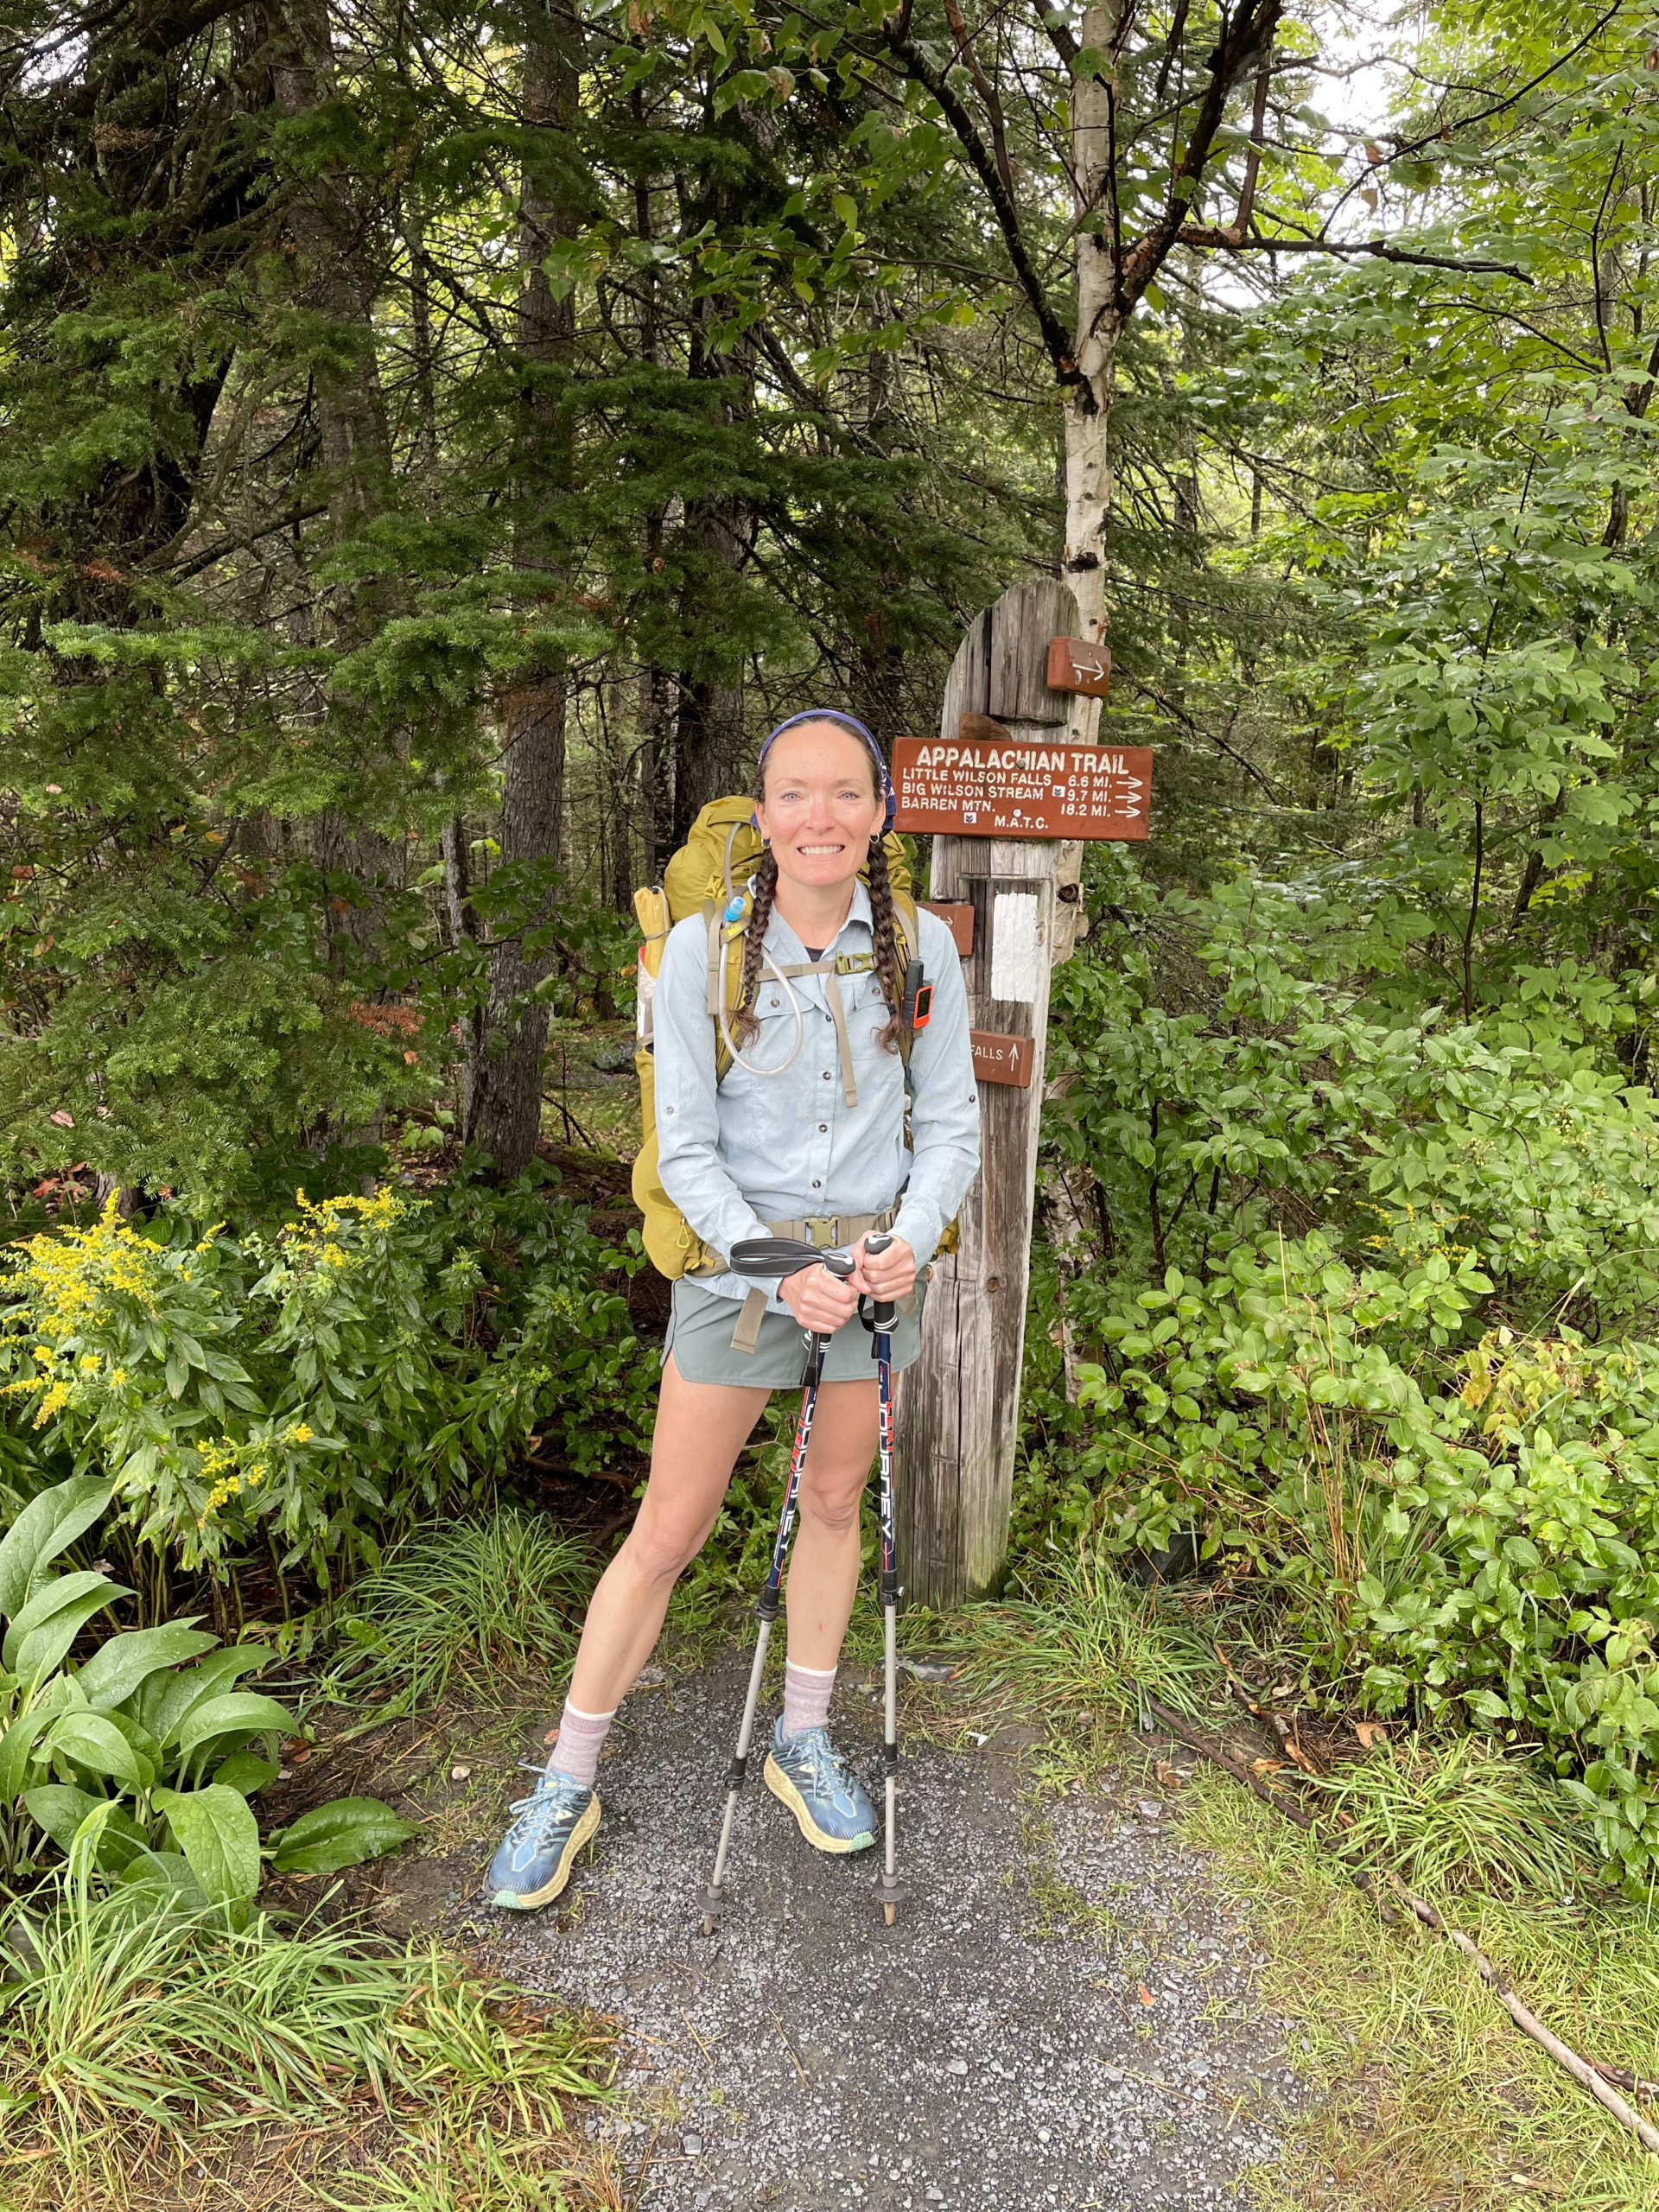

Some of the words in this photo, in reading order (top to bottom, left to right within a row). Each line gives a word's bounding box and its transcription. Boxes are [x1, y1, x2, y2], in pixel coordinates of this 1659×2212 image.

[916, 746, 1065, 771] APPALACHIAN
[1071, 753, 1129, 774] TRAIL
[903, 767, 949, 781] LITTLE
[952, 770, 1007, 784] WILSON
[1011, 772, 1052, 786] FALLS
[1068, 774, 1090, 788] 6.6
[1093, 776, 1113, 789] MI.
[902, 782, 926, 796] BIG
[931, 783, 984, 798] WILSON
[988, 785, 1044, 801] STREAM
[1067, 789, 1088, 802] 9.7
[1092, 790, 1112, 803] MI.
[901, 796, 957, 810] BARREN
[962, 798, 996, 812] MTN.
[1060, 803, 1087, 817] 18.2
[1090, 804, 1111, 818] MI.
[995, 815, 1049, 830] M.A.T.C.
